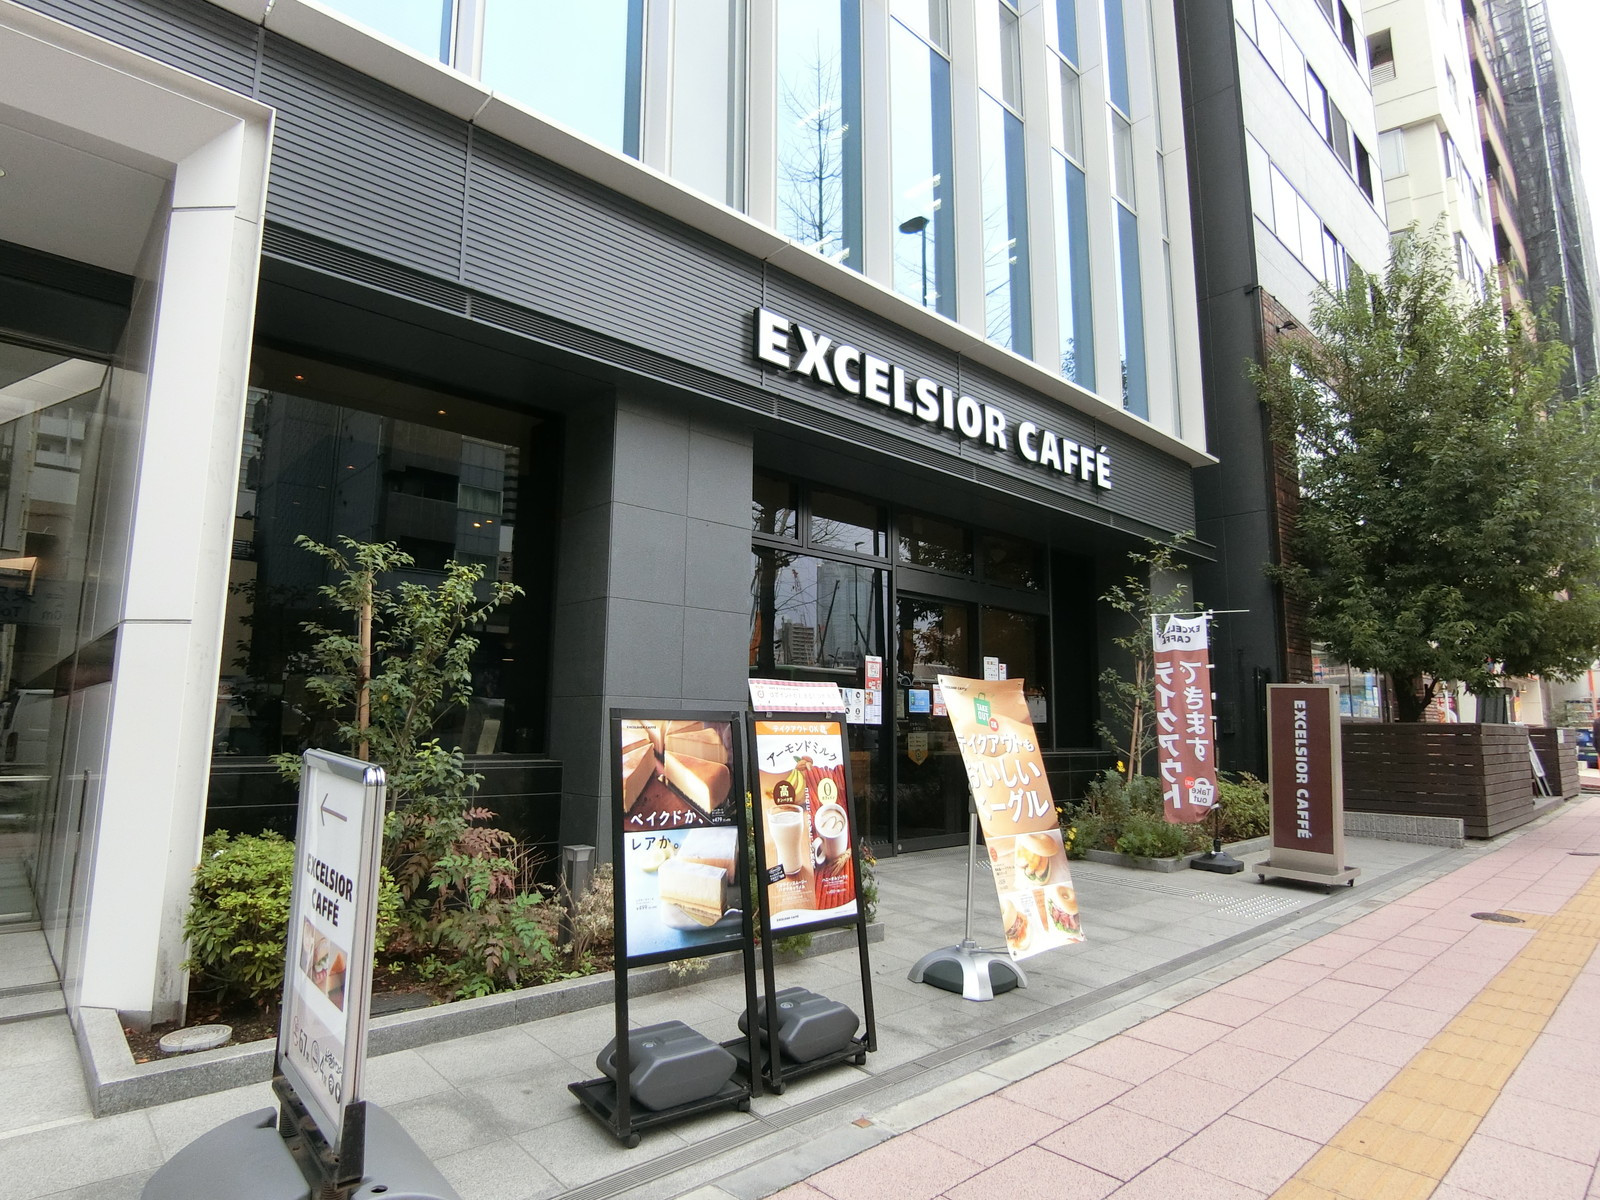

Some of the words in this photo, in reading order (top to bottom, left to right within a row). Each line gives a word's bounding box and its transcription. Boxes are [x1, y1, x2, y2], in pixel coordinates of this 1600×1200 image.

[756, 306, 1007, 452] EXCELSIOR
[1015, 420, 1113, 491] CAFFÉ
[976, 703, 989, 713] TAKE
[977, 711, 989, 722] OUT
[766, 740, 837, 767] アーモンドミルク
[1293, 700, 1308, 784] EXCELSIOR
[779, 785, 789, 797] 高
[630, 809, 704, 827] ベイクドか、
[1296, 788, 1312, 839] CAFFÉ
[632, 835, 680, 851] レアか。
[306, 853, 353, 903] EXCELSIOR
[311, 888, 339, 927] CAFFÉ
